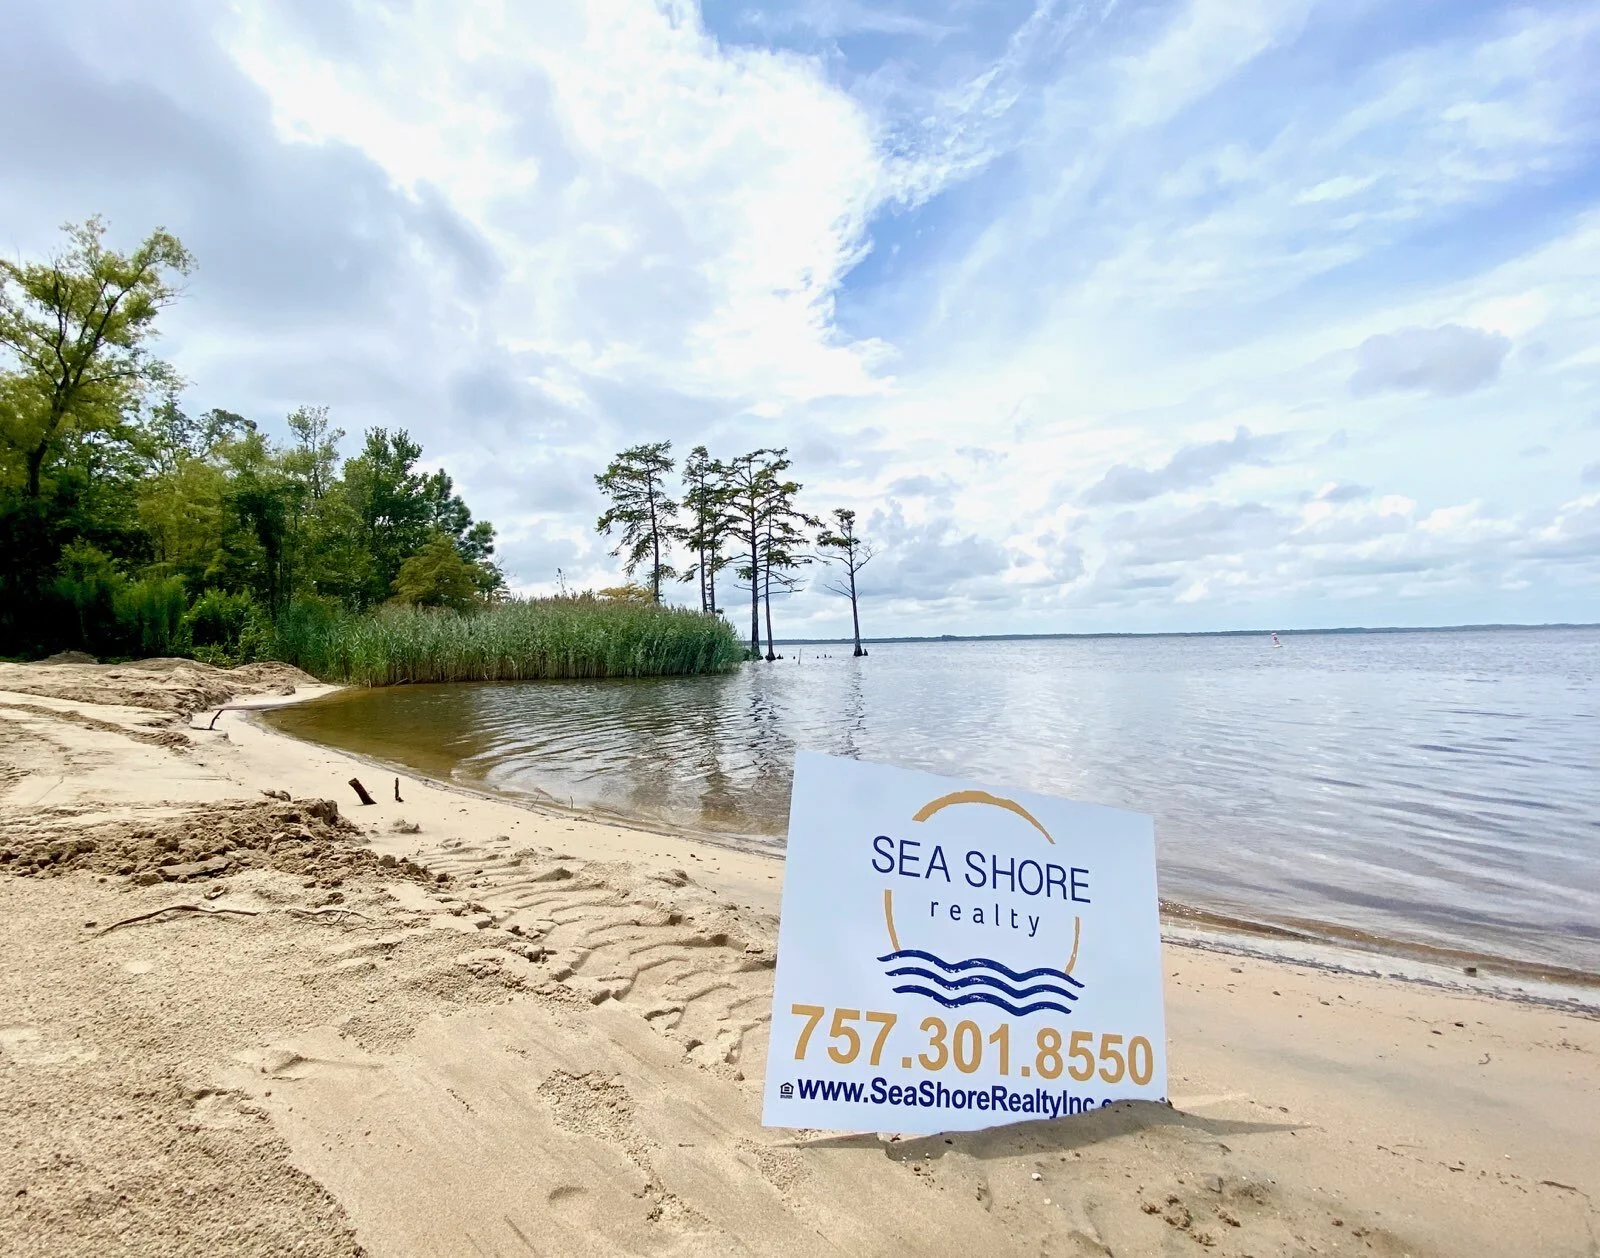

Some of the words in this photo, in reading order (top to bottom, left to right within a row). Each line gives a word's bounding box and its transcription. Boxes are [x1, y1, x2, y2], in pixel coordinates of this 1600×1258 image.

[871, 835, 951, 883] SEA
[964, 850, 1091, 904] SHORE
[930, 901, 1040, 938] realty
[790, 1003, 1154, 1086] 757.301.8550
[797, 1076, 1113, 1121] www.SeaShoreRealtyInc
